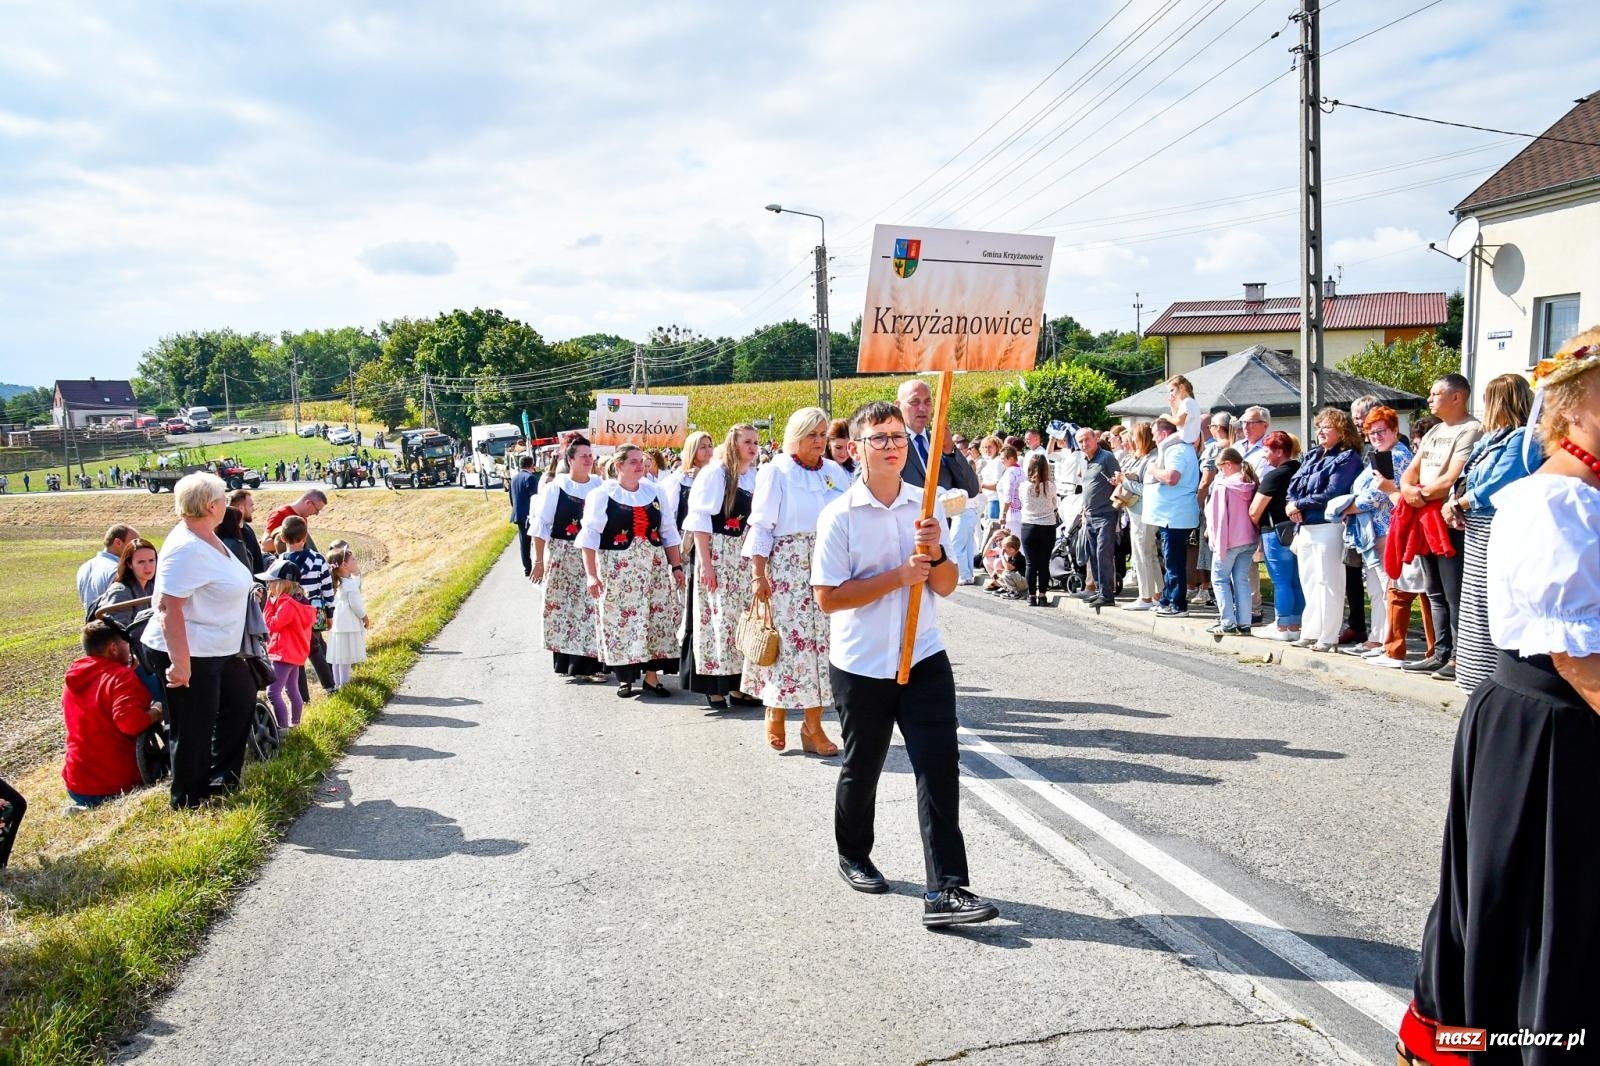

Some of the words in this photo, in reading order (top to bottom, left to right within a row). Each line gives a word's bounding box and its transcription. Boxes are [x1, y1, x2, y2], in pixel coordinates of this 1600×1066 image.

[982, 250, 1002, 258] Gmina
[1003, 251, 1044, 261] Krzyżanowice
[872, 306, 1033, 342] Krzyżanowice
[605, 419, 678, 435] Roszków
